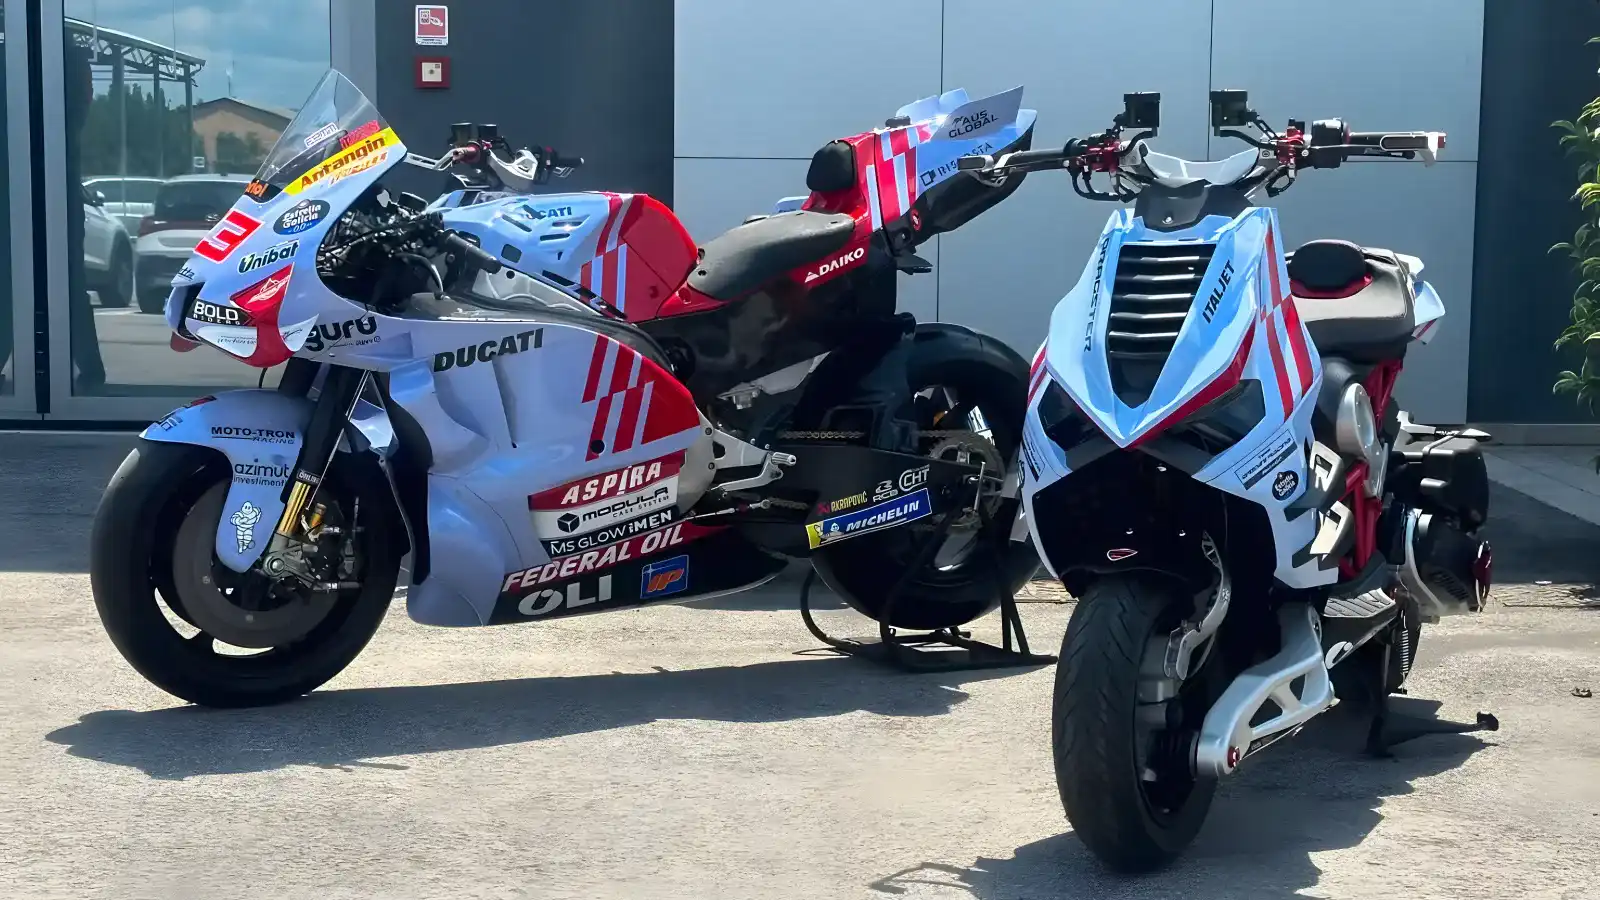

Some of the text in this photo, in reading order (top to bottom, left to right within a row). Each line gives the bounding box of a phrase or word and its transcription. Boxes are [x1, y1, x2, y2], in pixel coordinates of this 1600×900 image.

[949, 117, 999, 139] GLOBAL
[964, 110, 988, 126] AUS
[238, 241, 299, 273] Unibat
[819, 247, 865, 276] DAIKO
[1202, 260, 1235, 324] ITALJET
[194, 301, 239, 321] BOLD
[433, 328, 544, 372] DUCATI
[211, 427, 296, 439] MOTO-TRON
[234, 458, 290, 479] azimut
[582, 487, 668, 521] MODULA
[846, 500, 919, 532] MICHELIN
[551, 541, 575, 555] MS
[578, 526, 628, 549] GLOW
[502, 524, 683, 593] FEDERAL OIL
